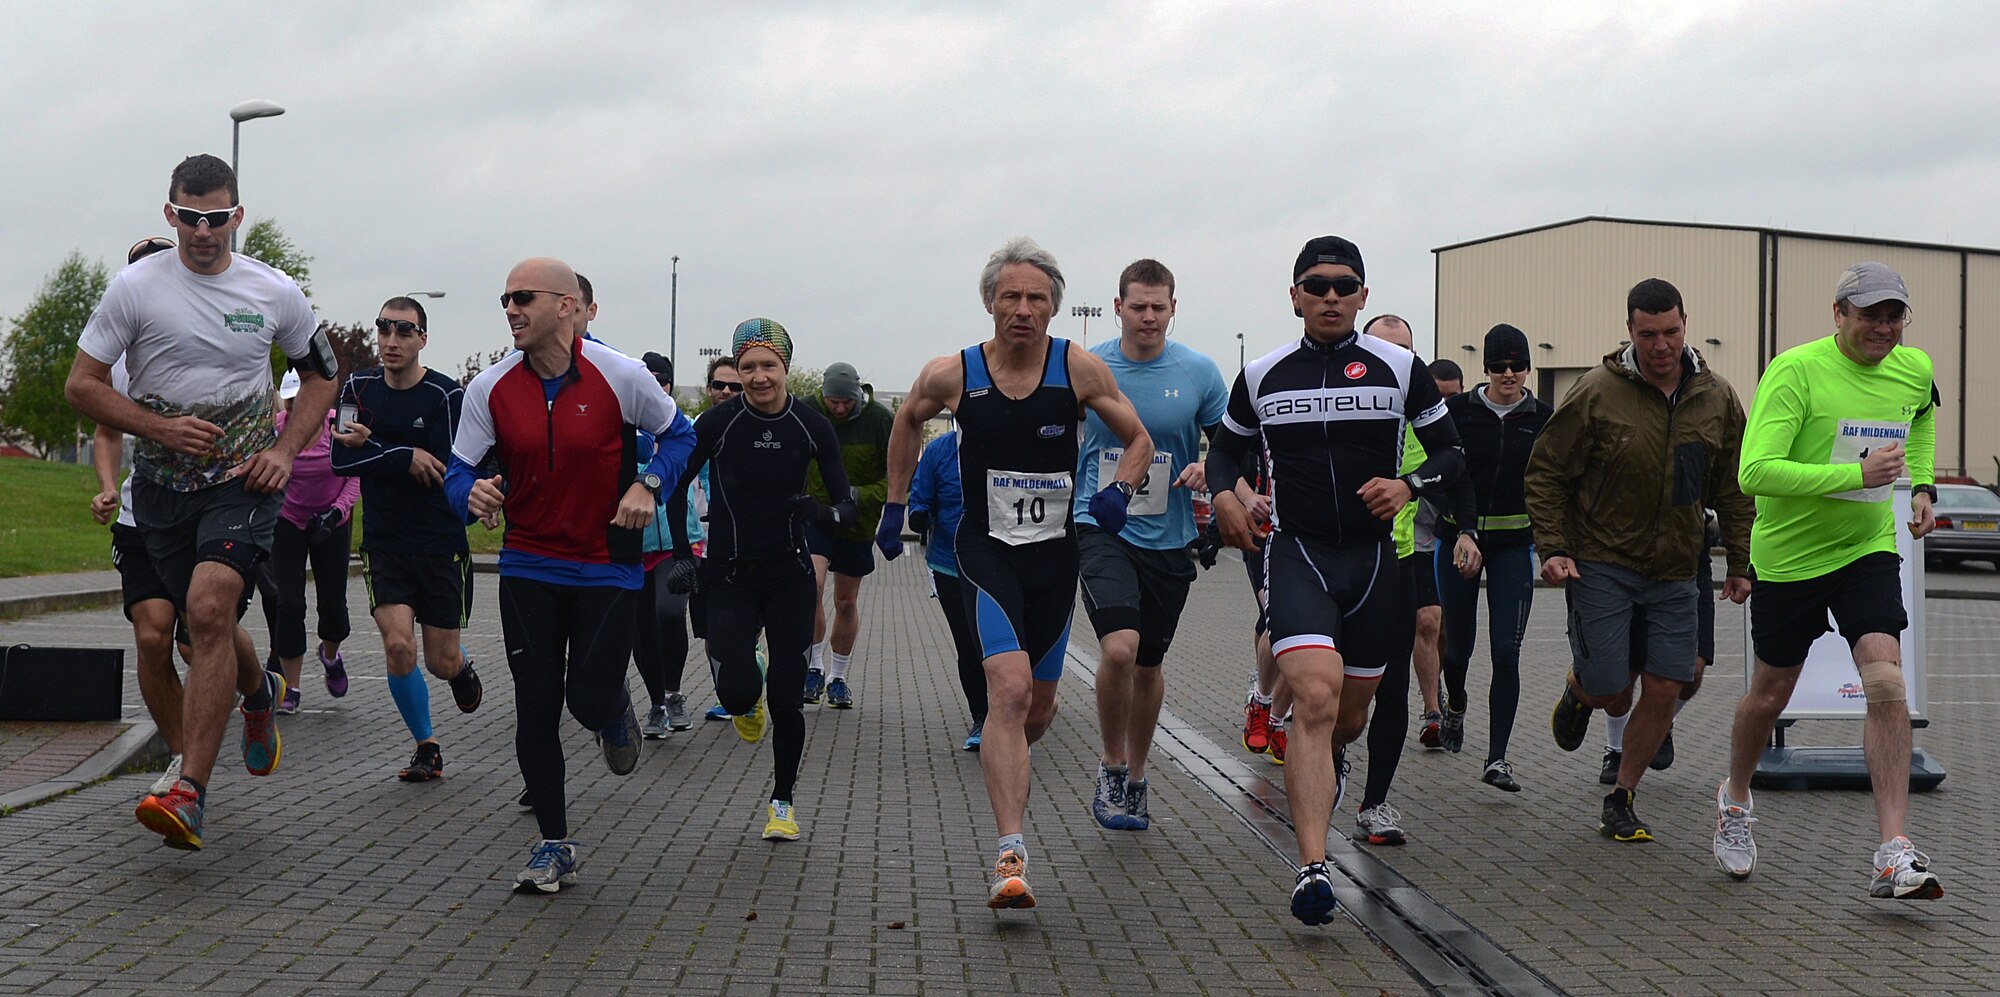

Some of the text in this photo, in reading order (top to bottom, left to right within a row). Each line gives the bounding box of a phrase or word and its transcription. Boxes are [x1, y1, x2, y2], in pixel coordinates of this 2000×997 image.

[1843, 425, 1906, 439] RAF MILDENHALL
[1104, 452, 1119, 462] RAF
[993, 476, 1067, 489] RAF MILDENHALL
[1013, 496, 1046, 526] 10
